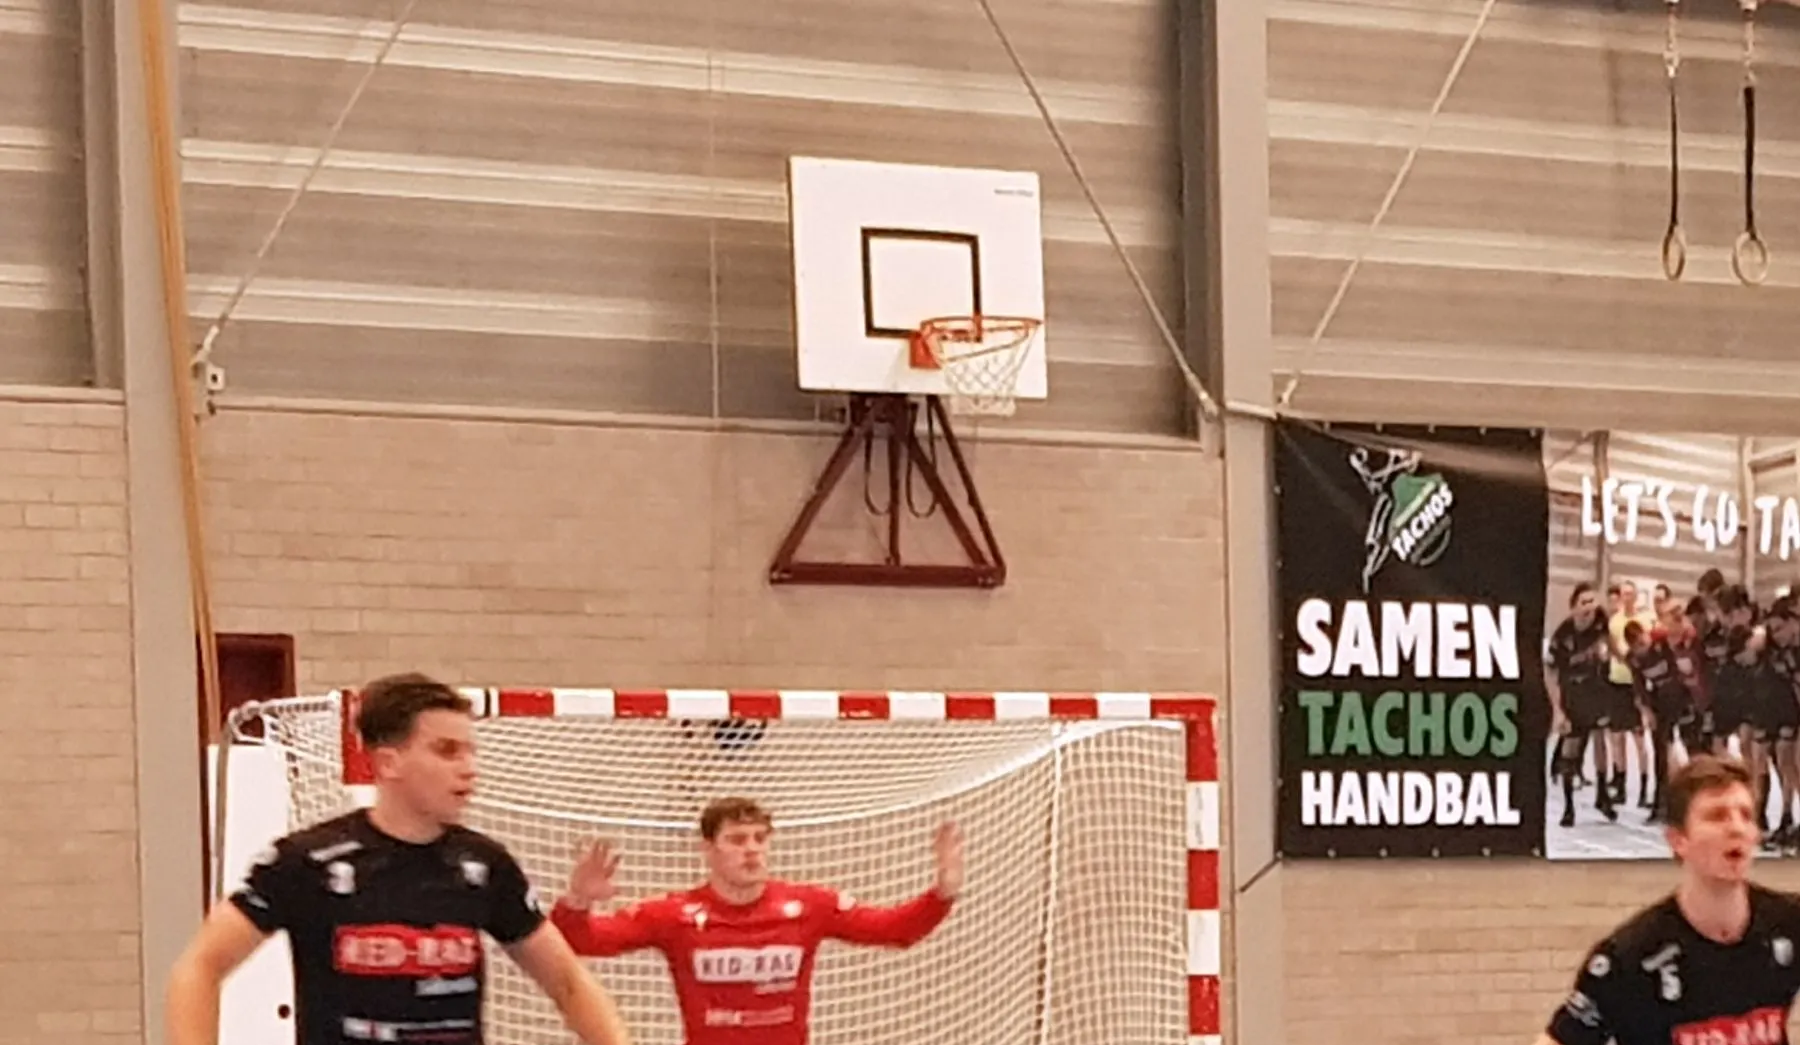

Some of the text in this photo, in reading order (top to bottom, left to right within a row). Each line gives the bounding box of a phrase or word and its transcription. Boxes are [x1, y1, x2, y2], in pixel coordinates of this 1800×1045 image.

[1392, 484, 1454, 561] TACHOS
[1581, 475, 1679, 548] LET'S
[1692, 484, 1739, 552] GO
[1296, 598, 1521, 680] SAMEN
[1298, 690, 1519, 758] TACHOS
[1300, 770, 1522, 827] HANDBAL
